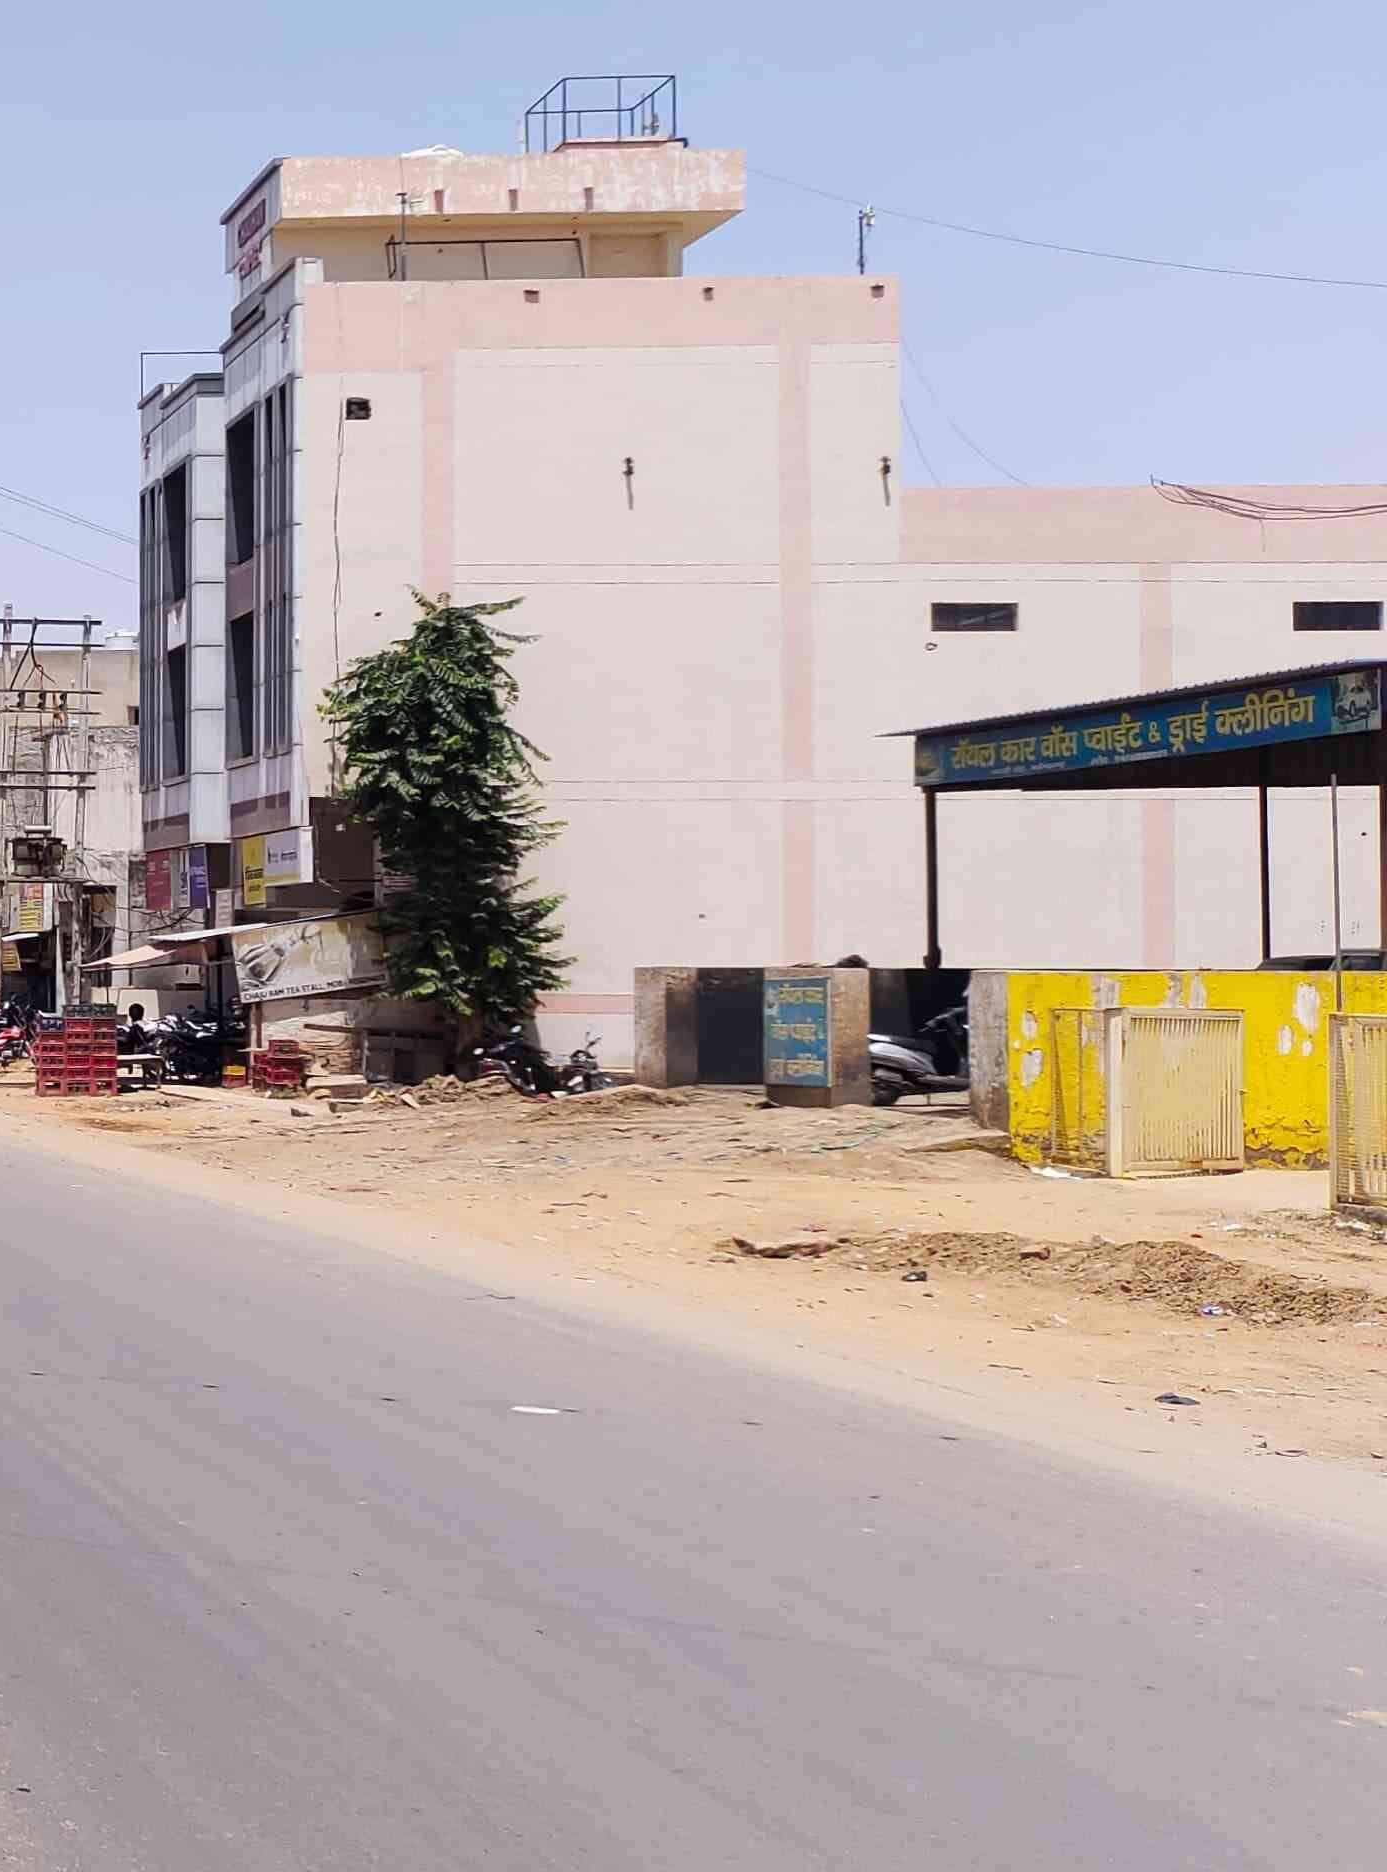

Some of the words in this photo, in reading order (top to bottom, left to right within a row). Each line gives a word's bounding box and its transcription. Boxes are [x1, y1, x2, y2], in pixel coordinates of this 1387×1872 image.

[1001, 737, 1036, 764] कार
[1147, 721, 1161, 744] &
[286, 986, 300, 995] TEA
